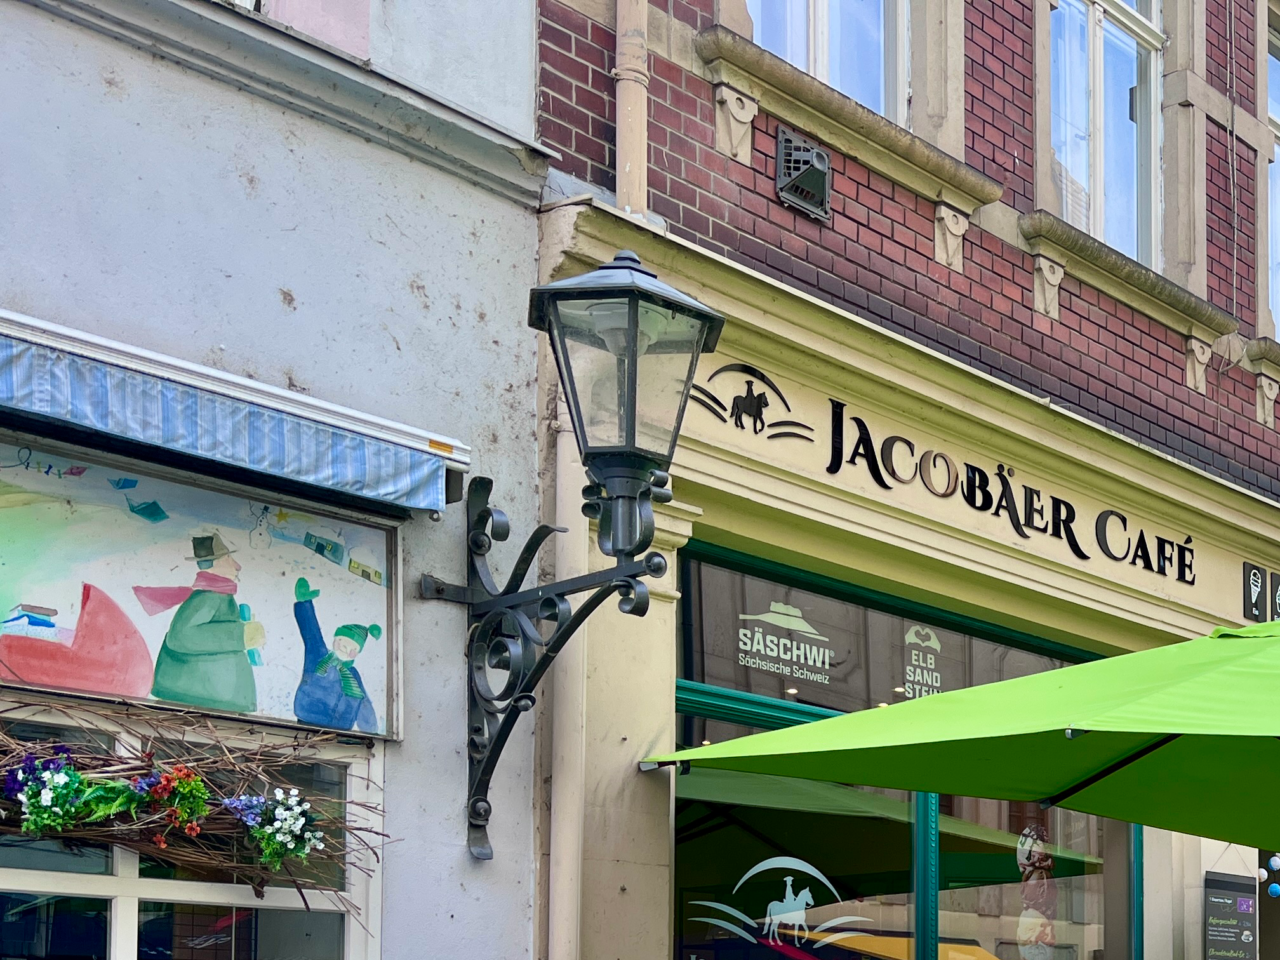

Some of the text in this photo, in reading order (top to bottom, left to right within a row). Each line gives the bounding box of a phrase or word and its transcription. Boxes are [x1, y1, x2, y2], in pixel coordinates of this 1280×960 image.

[739, 653, 829, 684] Sächsische Schweiz
[911, 649, 935, 669] ELB
[906, 665, 941, 687] SAND
